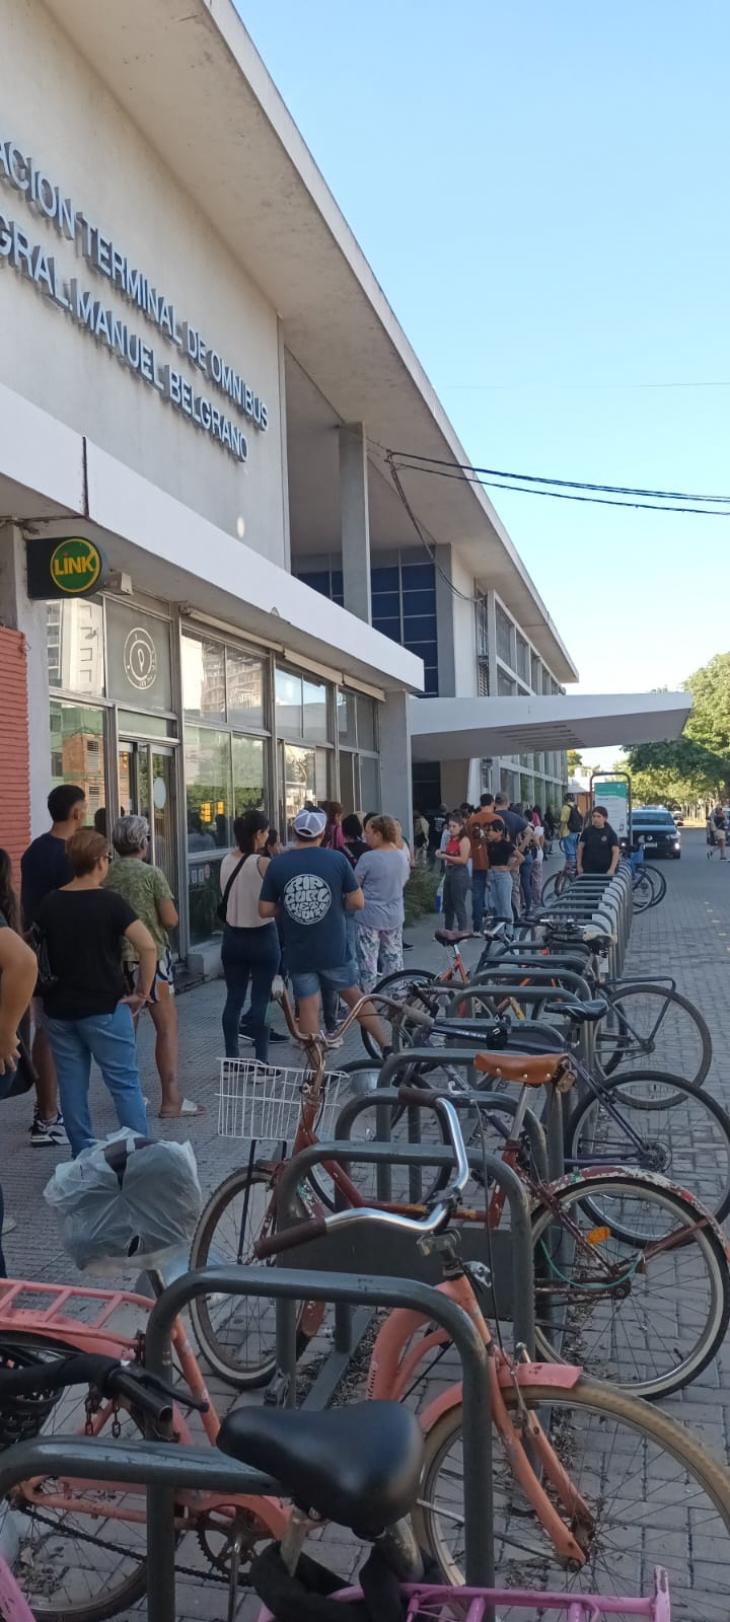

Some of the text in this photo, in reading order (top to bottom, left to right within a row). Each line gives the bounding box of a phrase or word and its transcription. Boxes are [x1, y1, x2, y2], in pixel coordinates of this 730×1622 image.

[75, 283, 163, 391] MANUEL
[166, 365, 248, 462] BELGRANO
[76, 213, 182, 345] TERMINAL
[185, 323, 207, 370] DE
[210, 350, 268, 431] OMNIBUS
